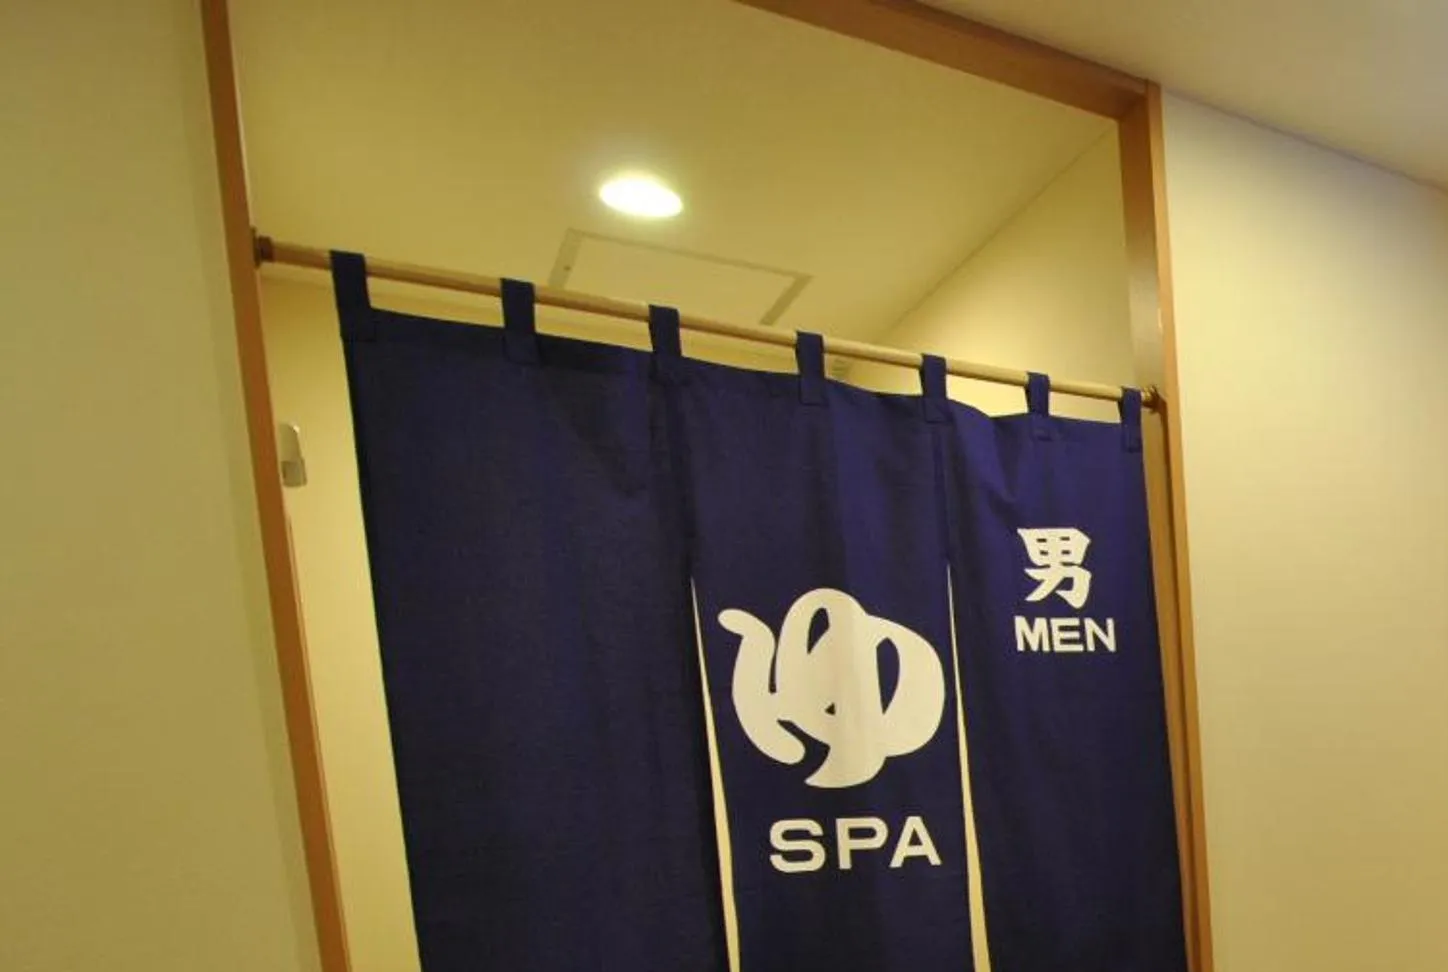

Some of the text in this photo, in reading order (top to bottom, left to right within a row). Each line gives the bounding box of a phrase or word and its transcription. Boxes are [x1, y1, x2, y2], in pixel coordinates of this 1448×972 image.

[1016, 527, 1093, 609] 男
[1014, 615, 1117, 653] MEN
[717, 587, 946, 789] ゆ
[769, 815, 942, 873] SPA
